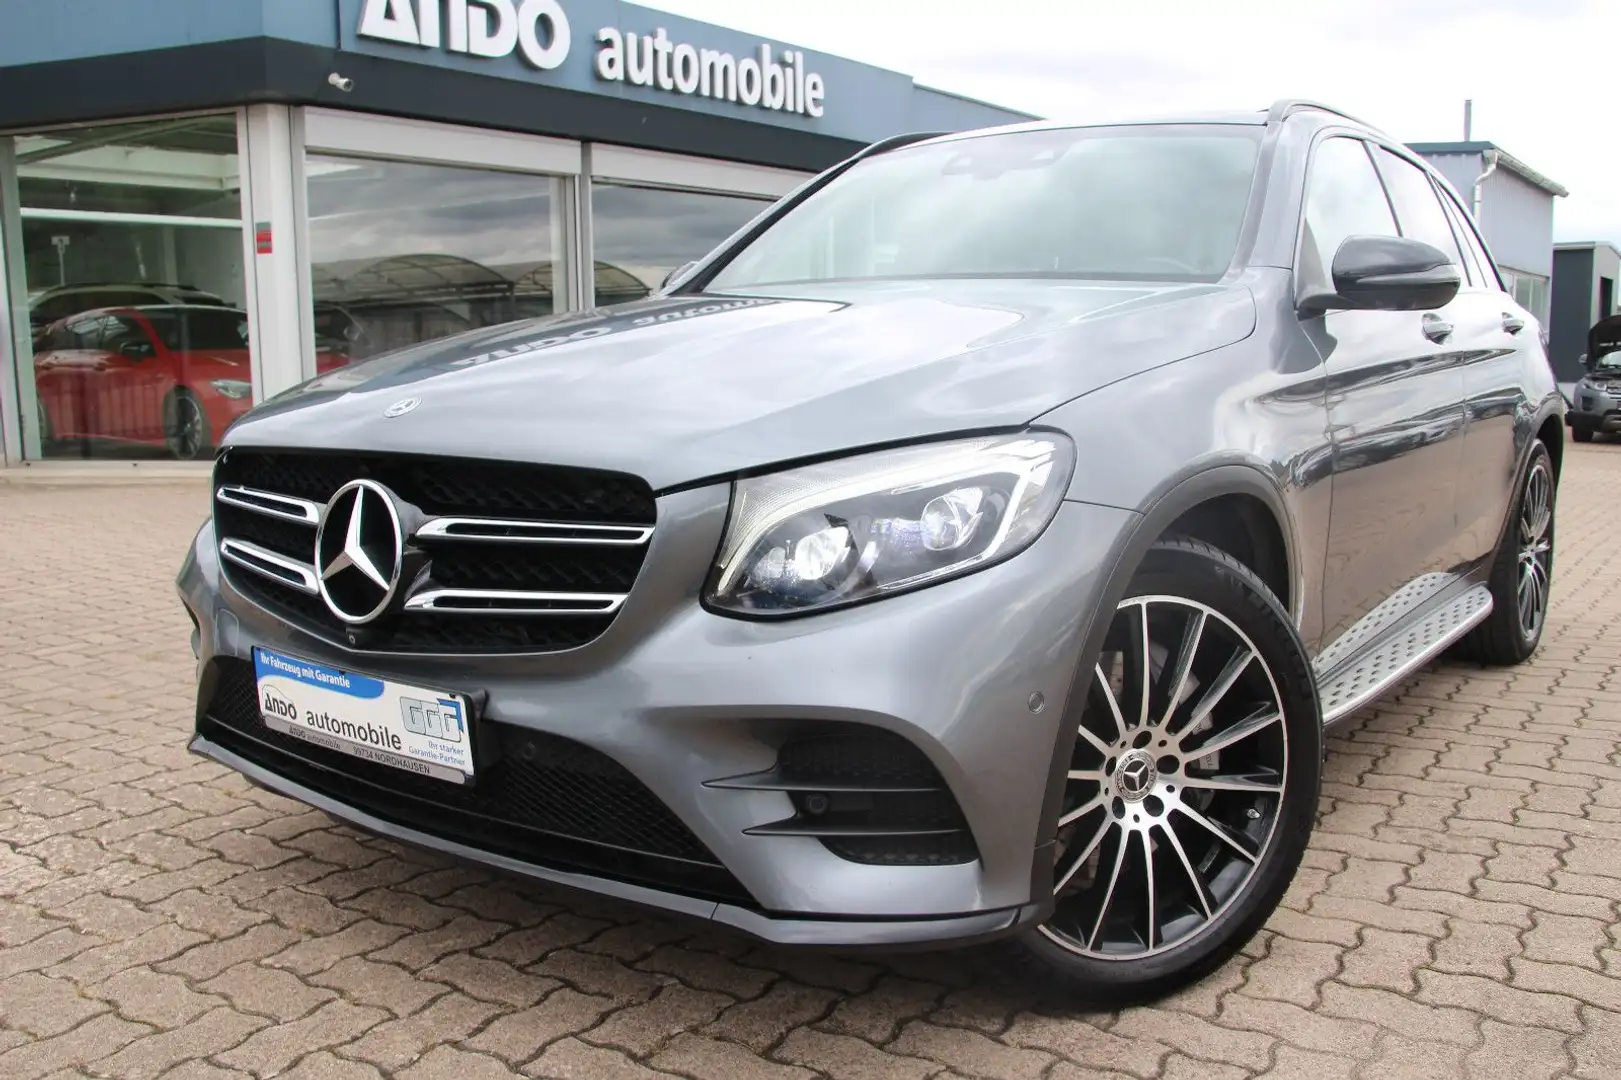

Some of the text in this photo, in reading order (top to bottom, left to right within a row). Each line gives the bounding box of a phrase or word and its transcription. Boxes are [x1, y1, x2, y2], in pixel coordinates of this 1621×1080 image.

[597, 27, 825, 117] automobile
[260, 652, 351, 688] Ihr Fahrzeug mit Garantie
[306, 710, 402, 750] automobile
[374, 752, 430, 774] NORDHAUSEN
